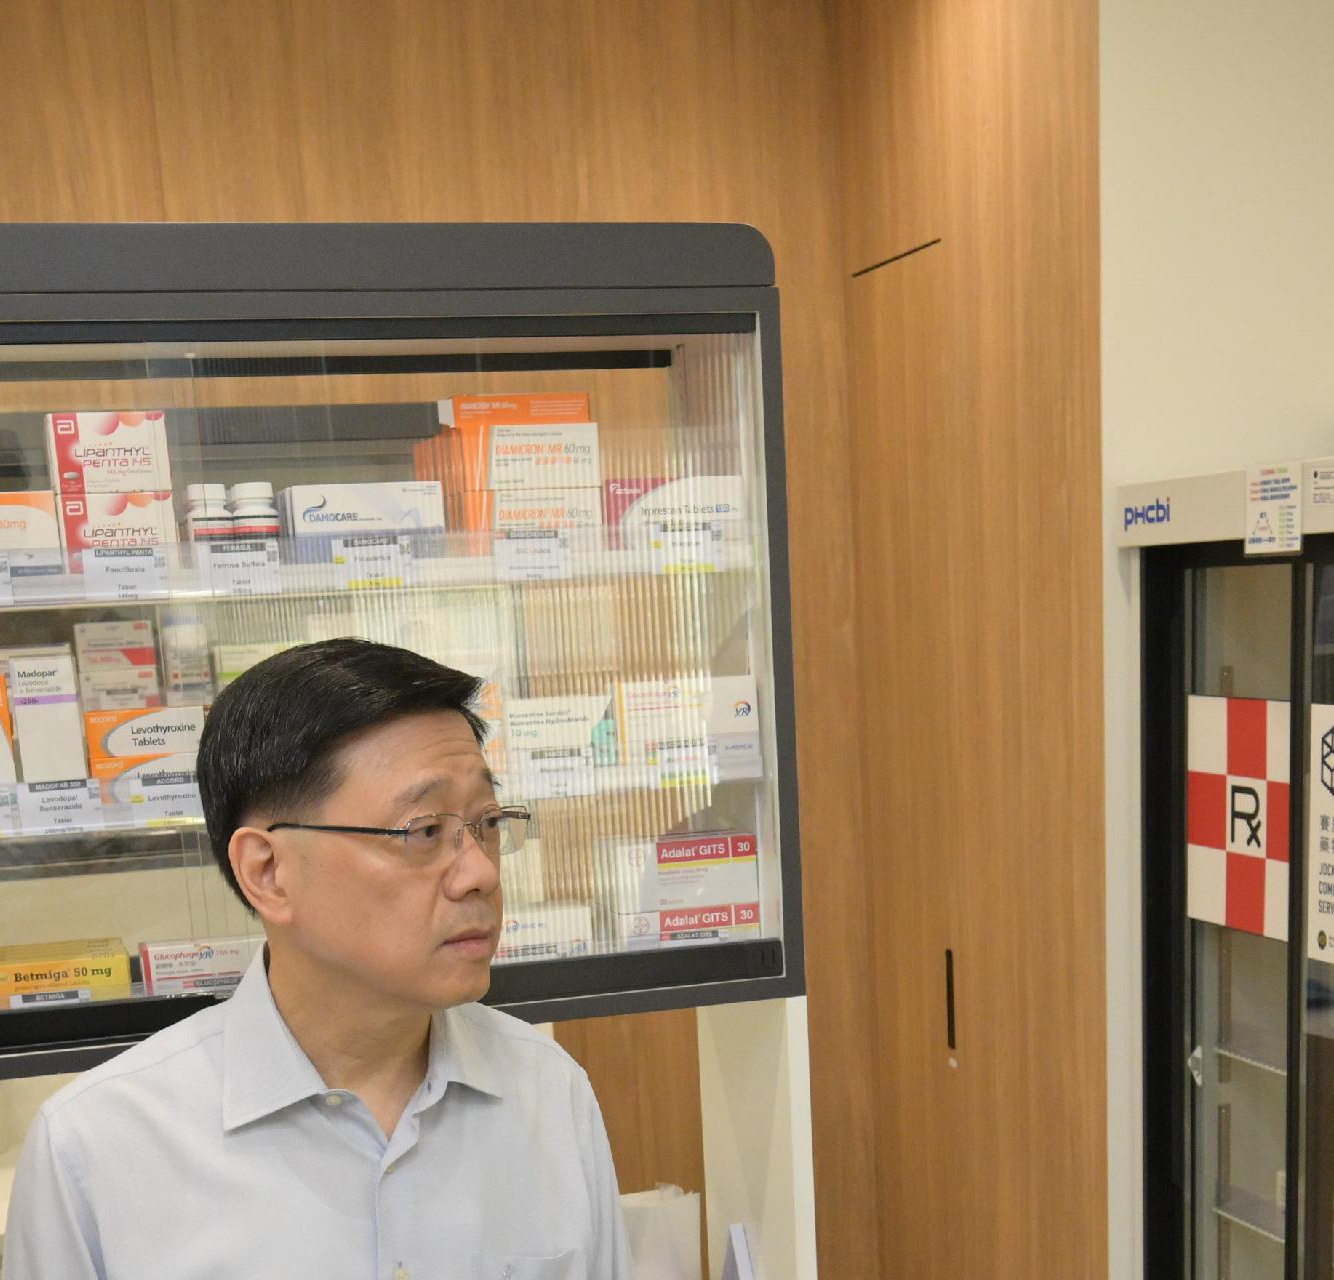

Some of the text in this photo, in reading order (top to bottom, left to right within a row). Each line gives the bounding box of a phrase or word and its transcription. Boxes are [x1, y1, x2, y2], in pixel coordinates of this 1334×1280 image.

[563, 443, 576, 454] 60
[576, 444, 590, 455] mg
[309, 512, 358, 523] DAMOCARE
[567, 507, 579, 518] 60
[131, 723, 196, 735] Levothyroxine
[523, 729, 538, 737] mg
[132, 738, 166, 747] Tablets
[35, 783, 68, 791] MADOPAR
[148, 793, 197, 801] Levothyroxine
[39, 803, 83, 812] Benserazide
[661, 841, 750, 859] Adalat GITS 30
[664, 909, 754, 927] Adalat GITS 30
[14, 967, 112, 983] Betmiga 50 mg
